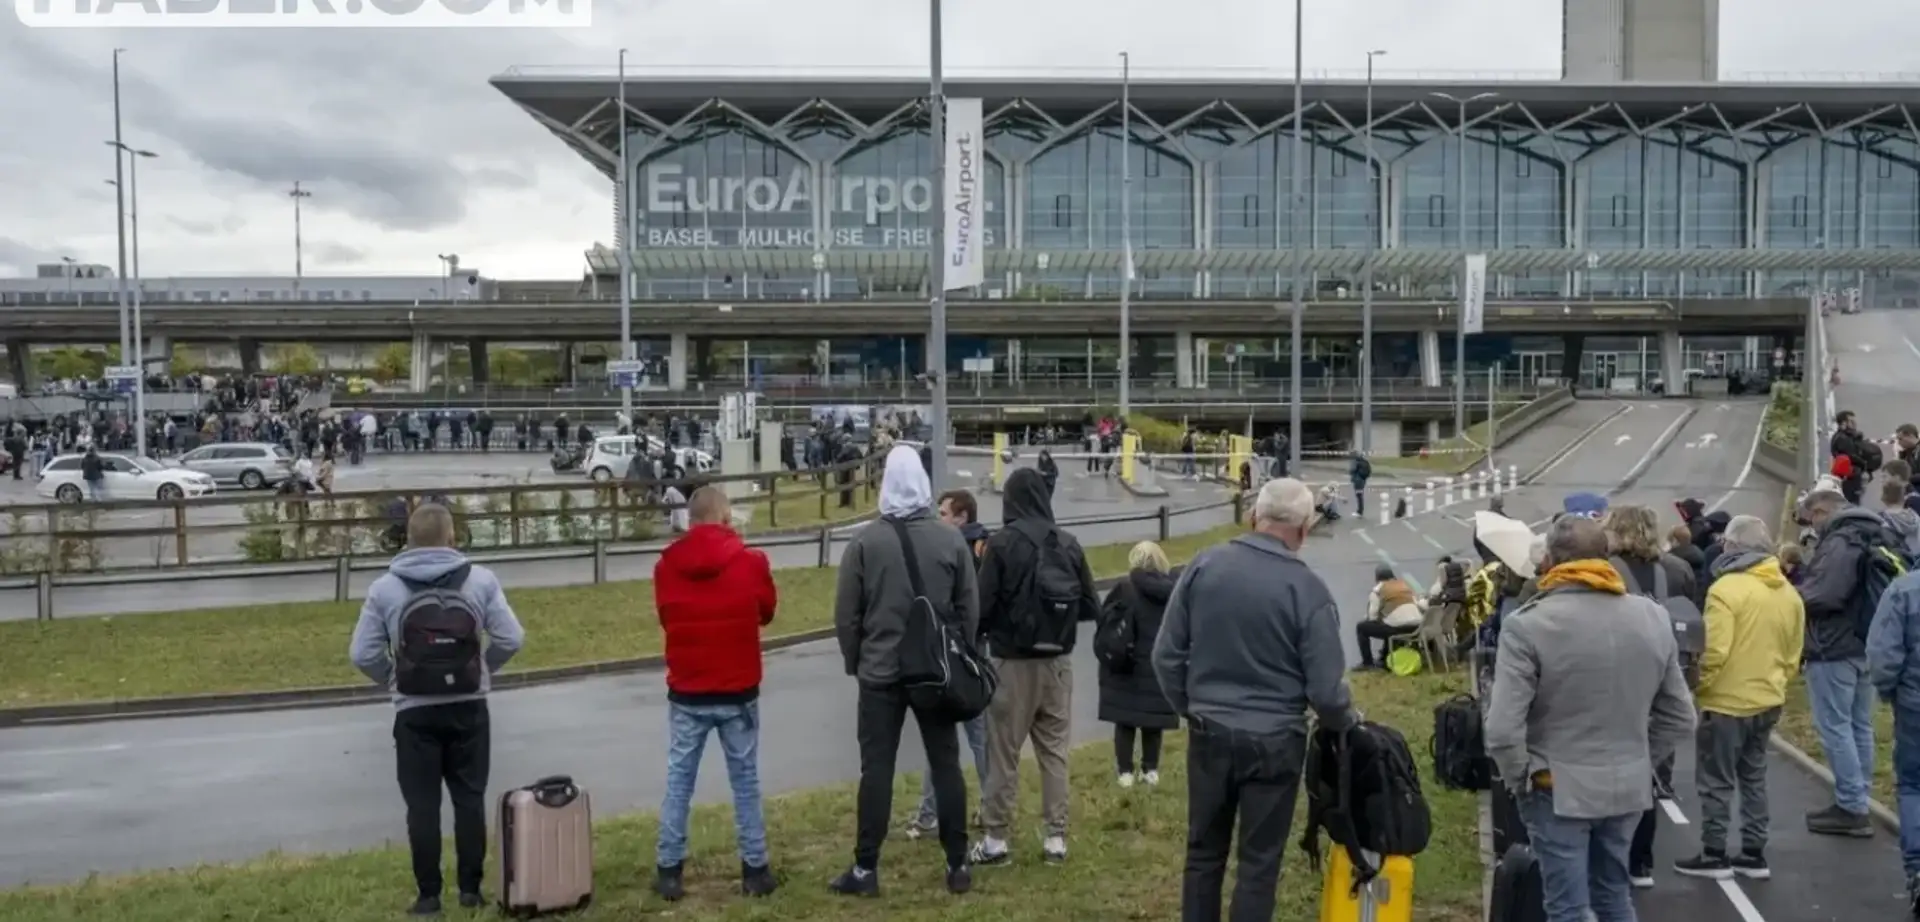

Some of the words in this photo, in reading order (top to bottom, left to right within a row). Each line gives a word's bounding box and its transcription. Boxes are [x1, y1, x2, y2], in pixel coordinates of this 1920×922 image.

[649, 229, 719, 246] BASEL
[738, 228, 863, 246] MULHOSE
[884, 228, 994, 246] FREIG
